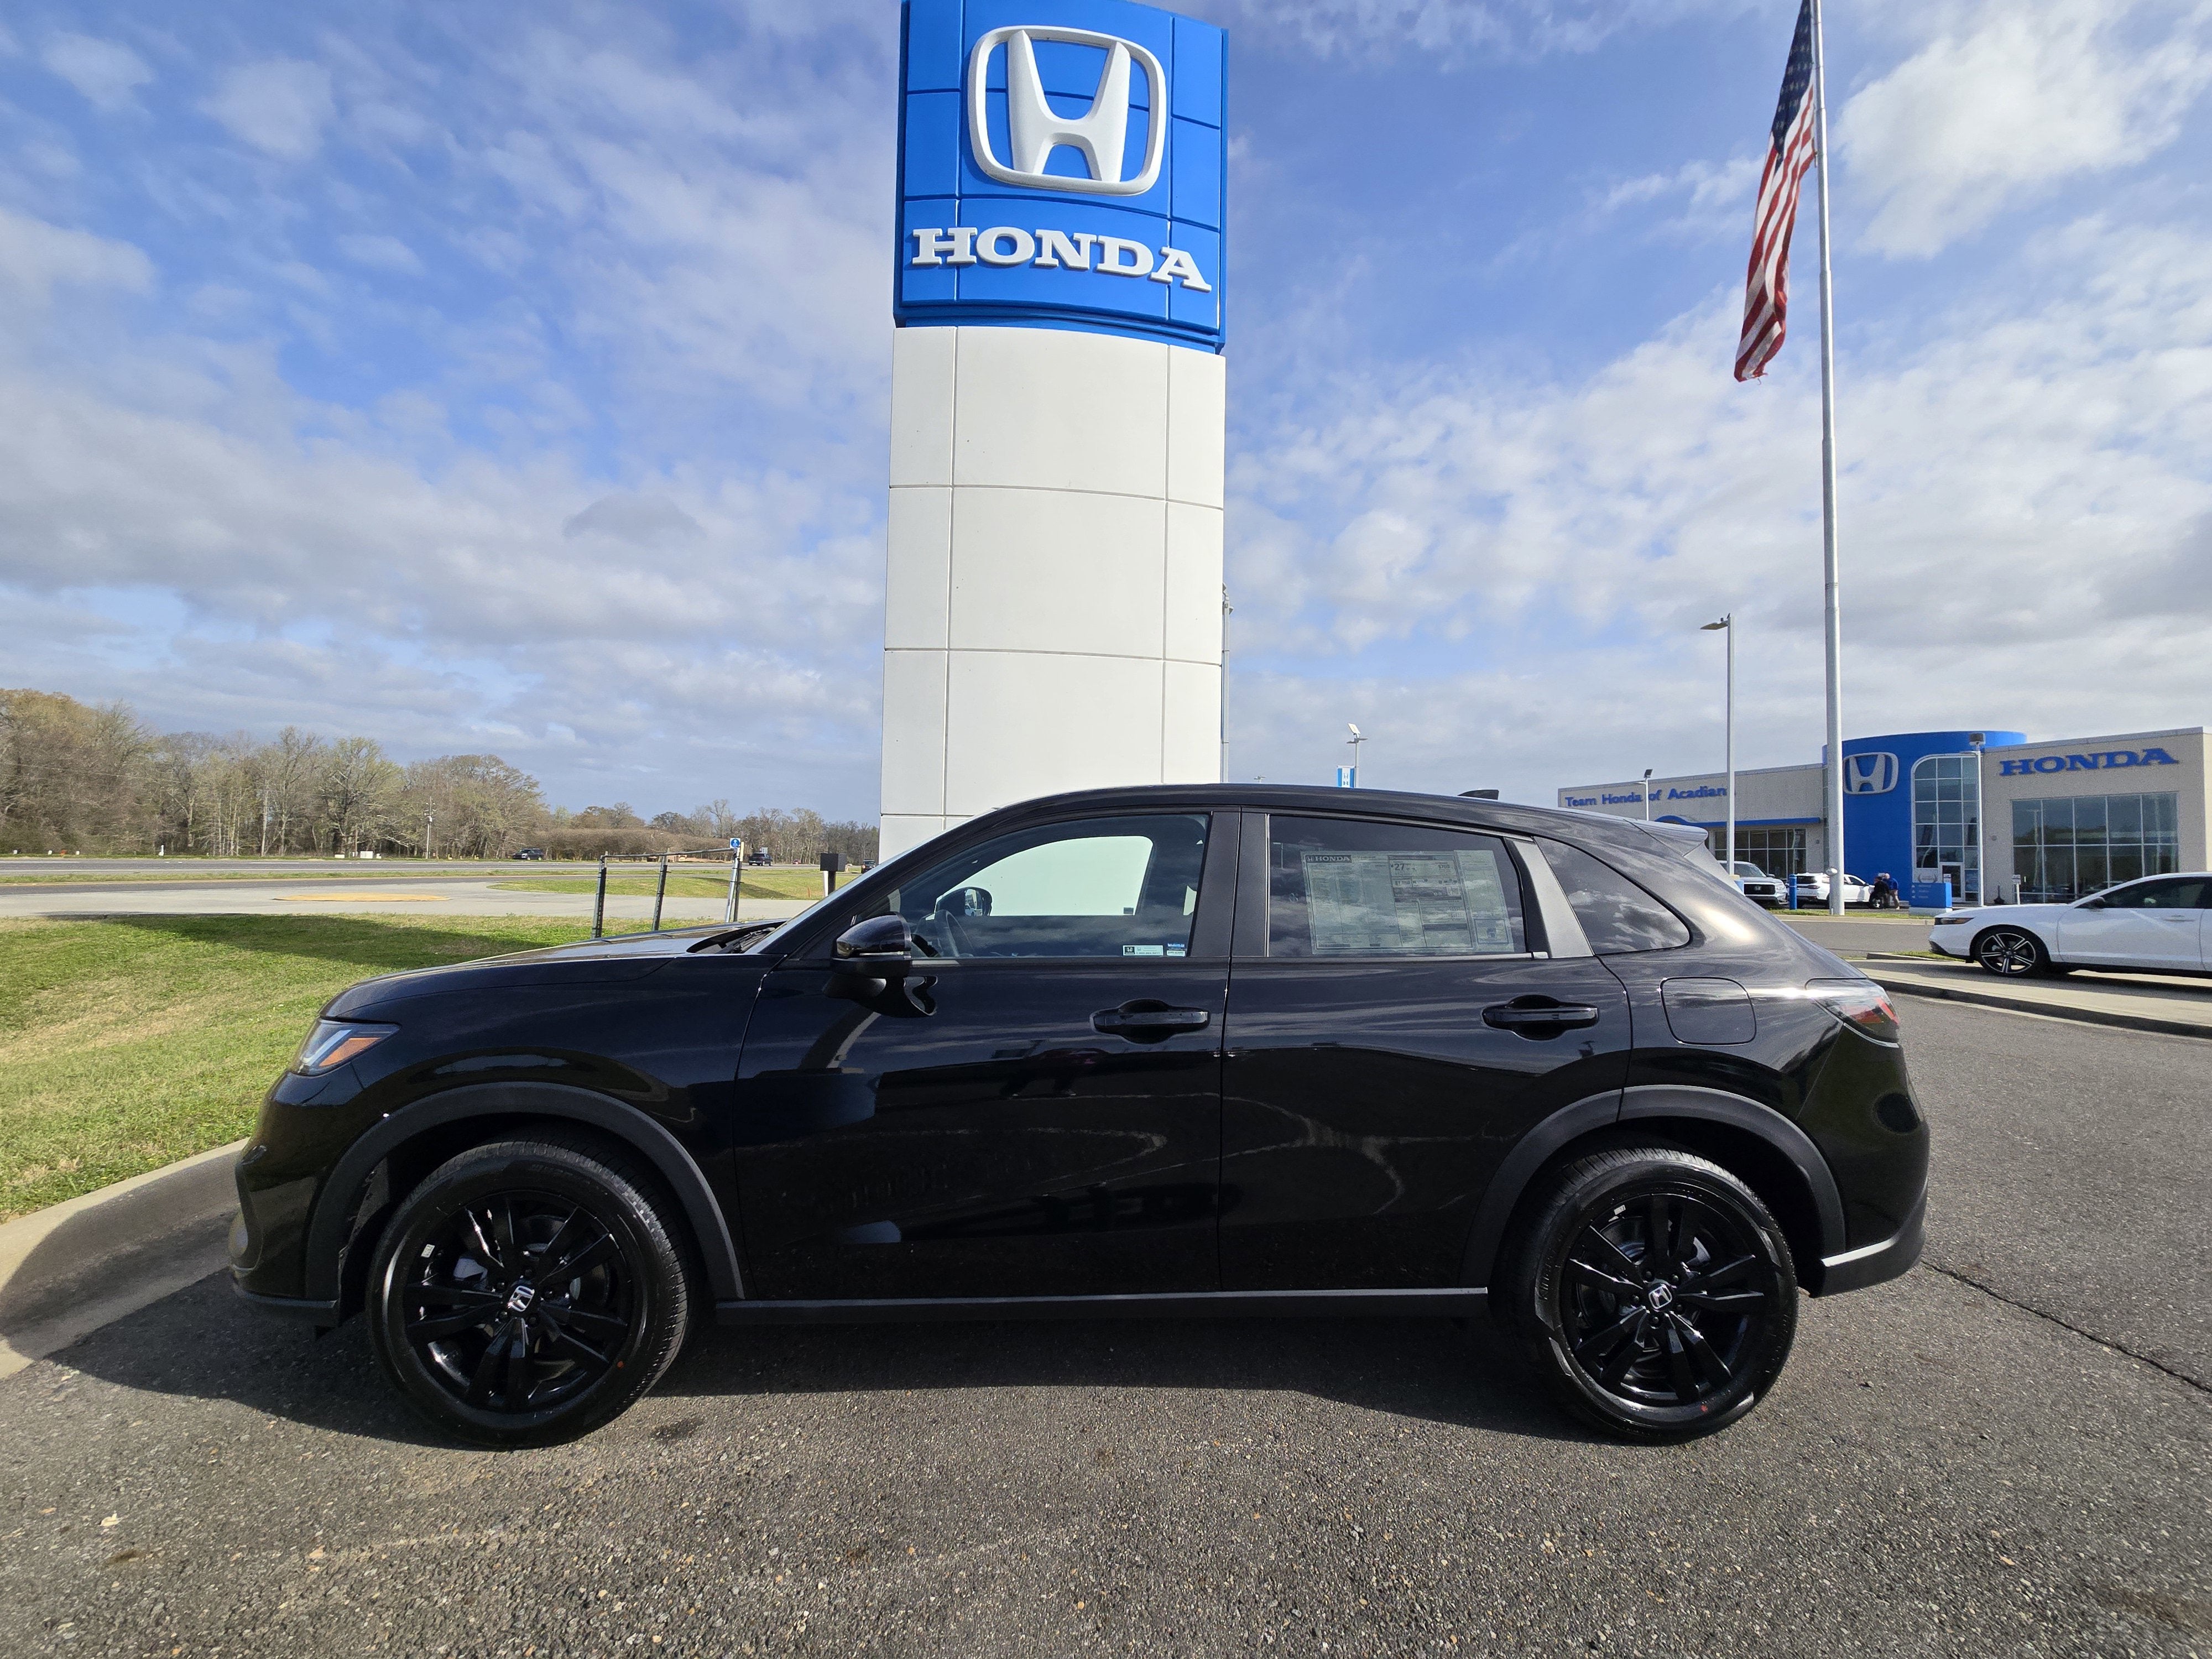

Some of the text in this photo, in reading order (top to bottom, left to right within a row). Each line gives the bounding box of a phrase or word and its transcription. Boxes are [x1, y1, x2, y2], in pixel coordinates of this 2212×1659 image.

[912, 227, 1212, 293] HONDA
[1999, 748, 2179, 776] HONDA
[1565, 797, 1597, 806] Team
[1601, 791, 1643, 805] Honda
[1648, 789, 1662, 801] of
